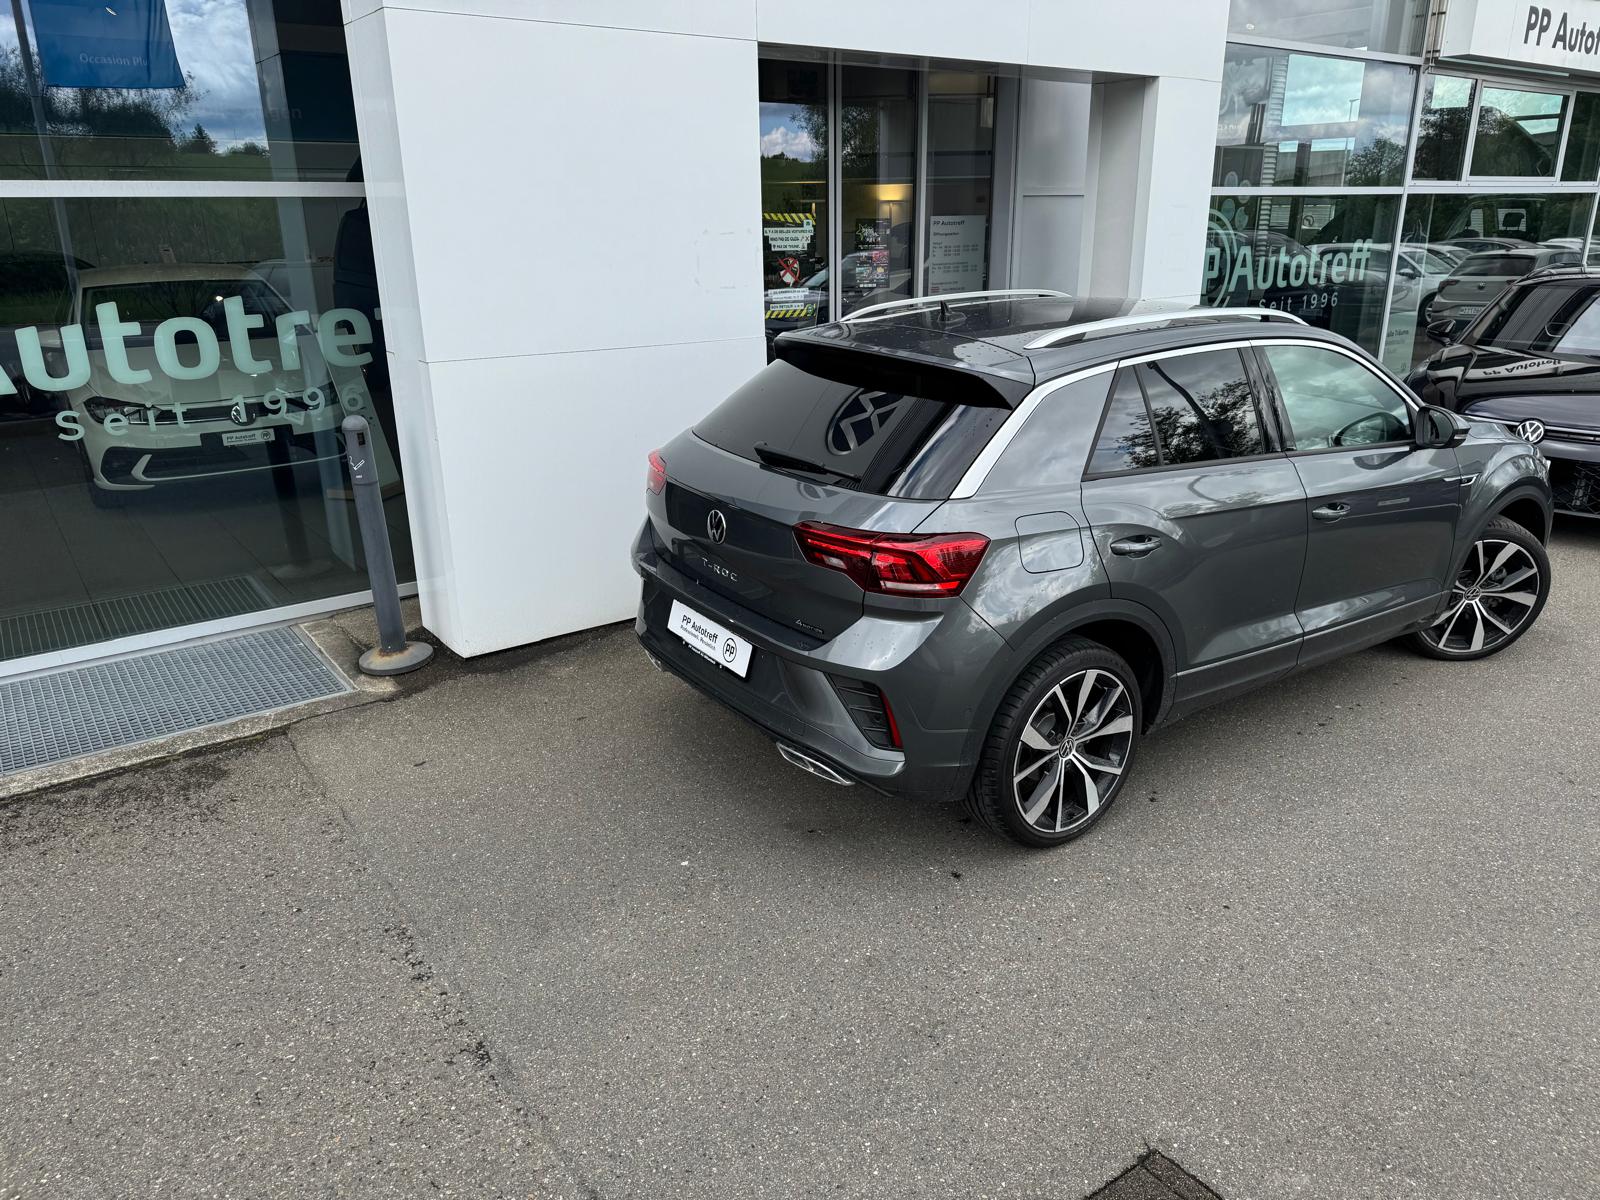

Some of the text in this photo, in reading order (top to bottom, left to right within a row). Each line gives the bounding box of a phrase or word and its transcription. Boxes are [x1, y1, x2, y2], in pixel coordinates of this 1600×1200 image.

[1523, 5, 1552, 46] PP
[79, 53, 148, 66] Occasion Plu
[1228, 238, 1374, 293] Autotreff
[1302, 292, 1339, 310] 1996
[0, 296, 381, 394] utotre
[55, 382, 364, 440] seit 1996
[702, 557, 738, 582] T-ROC
[681, 614, 719, 644] PP Autotreff
[724, 643, 735, 657] PP
